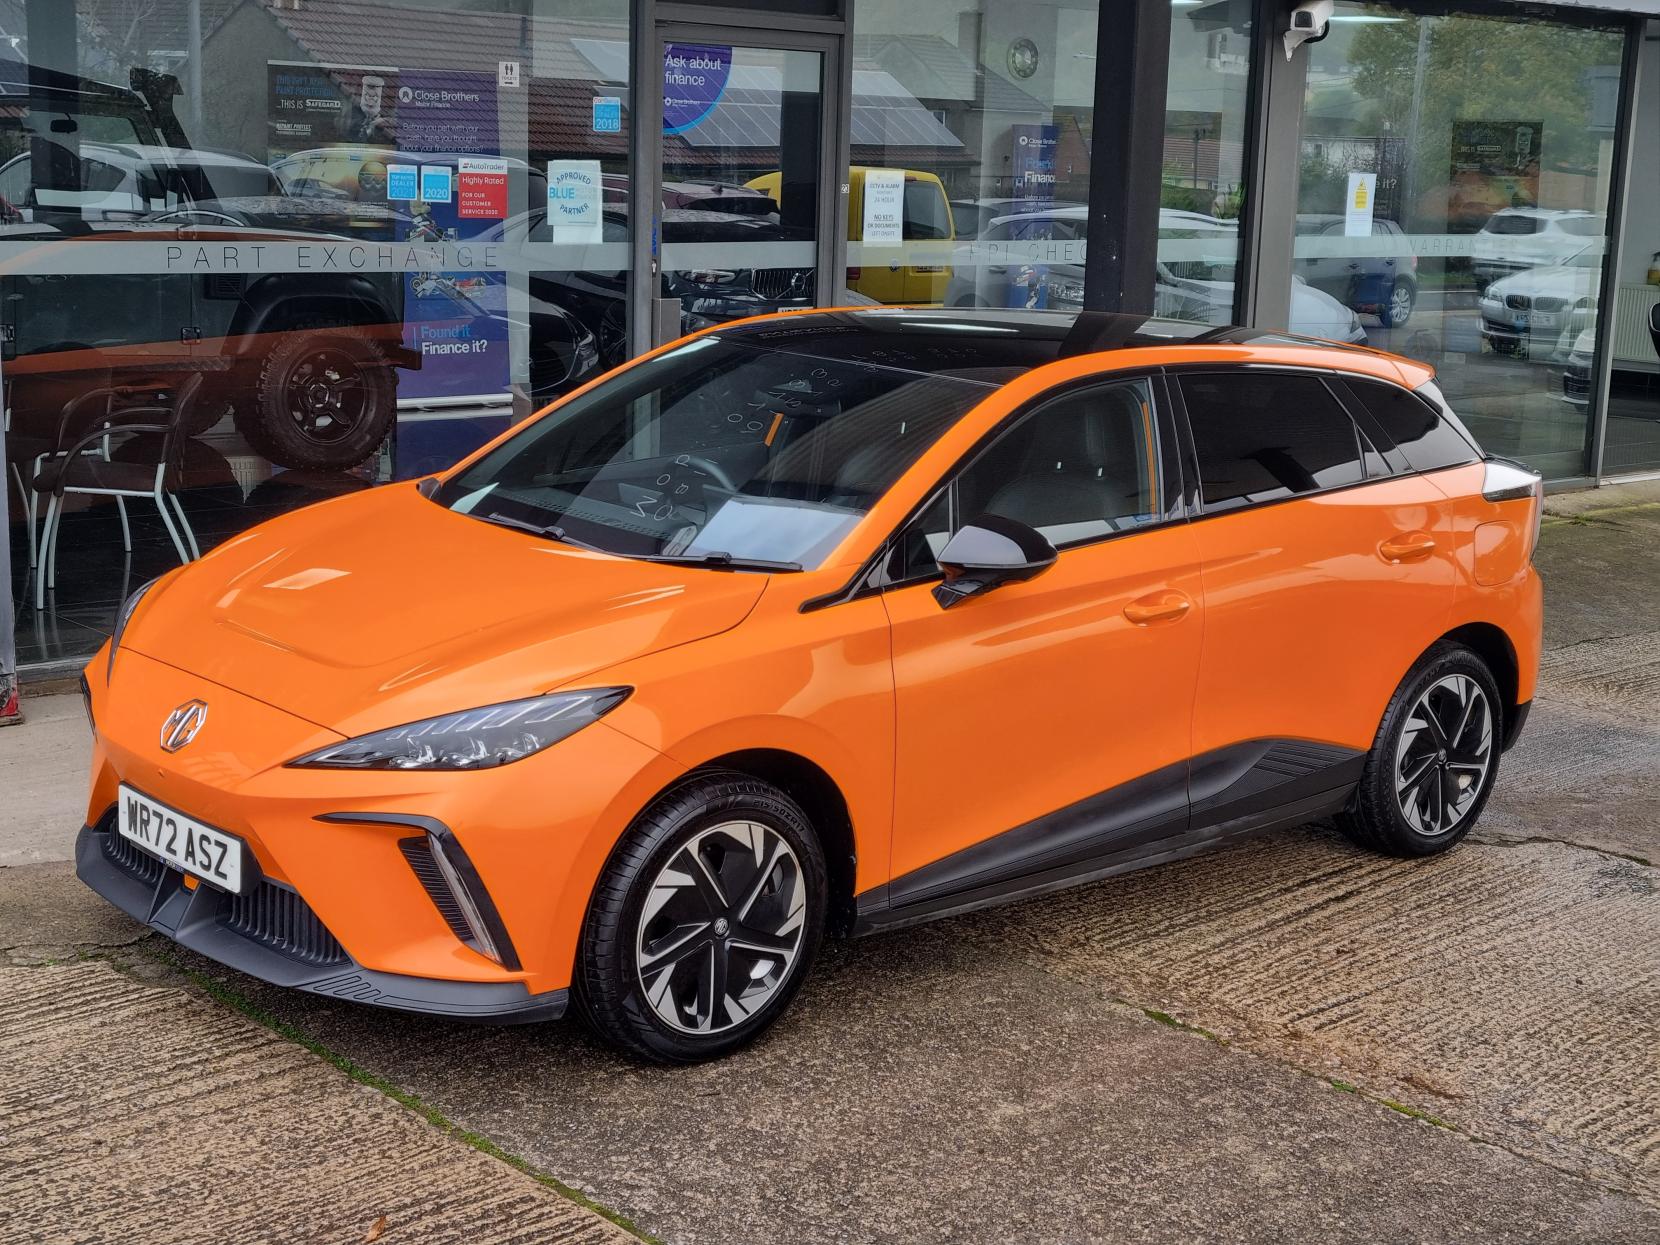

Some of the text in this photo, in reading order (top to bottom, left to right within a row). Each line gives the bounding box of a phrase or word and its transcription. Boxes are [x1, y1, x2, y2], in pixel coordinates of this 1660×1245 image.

[665, 54, 721, 70] Ask about
[665, 71, 705, 86] finance
[415, 90, 480, 102] Close Brothers
[296, 100, 304, 109] IS
[596, 118, 619, 129] 2018
[469, 162, 505, 171] AutoTrader
[462, 176, 504, 185] Highly Rated
[556, 171, 591, 185] APPROVED
[425, 189, 448, 198] 2020
[549, 186, 575, 199] BLUE
[560, 203, 590, 215] PARTNER
[167, 246, 497, 268] PART EXCHANGE
[421, 324, 471, 338] Found it
[422, 339, 488, 355] Finance it?
[161, 700, 207, 752] MG
[127, 796, 228, 881] WR72 ASZ
